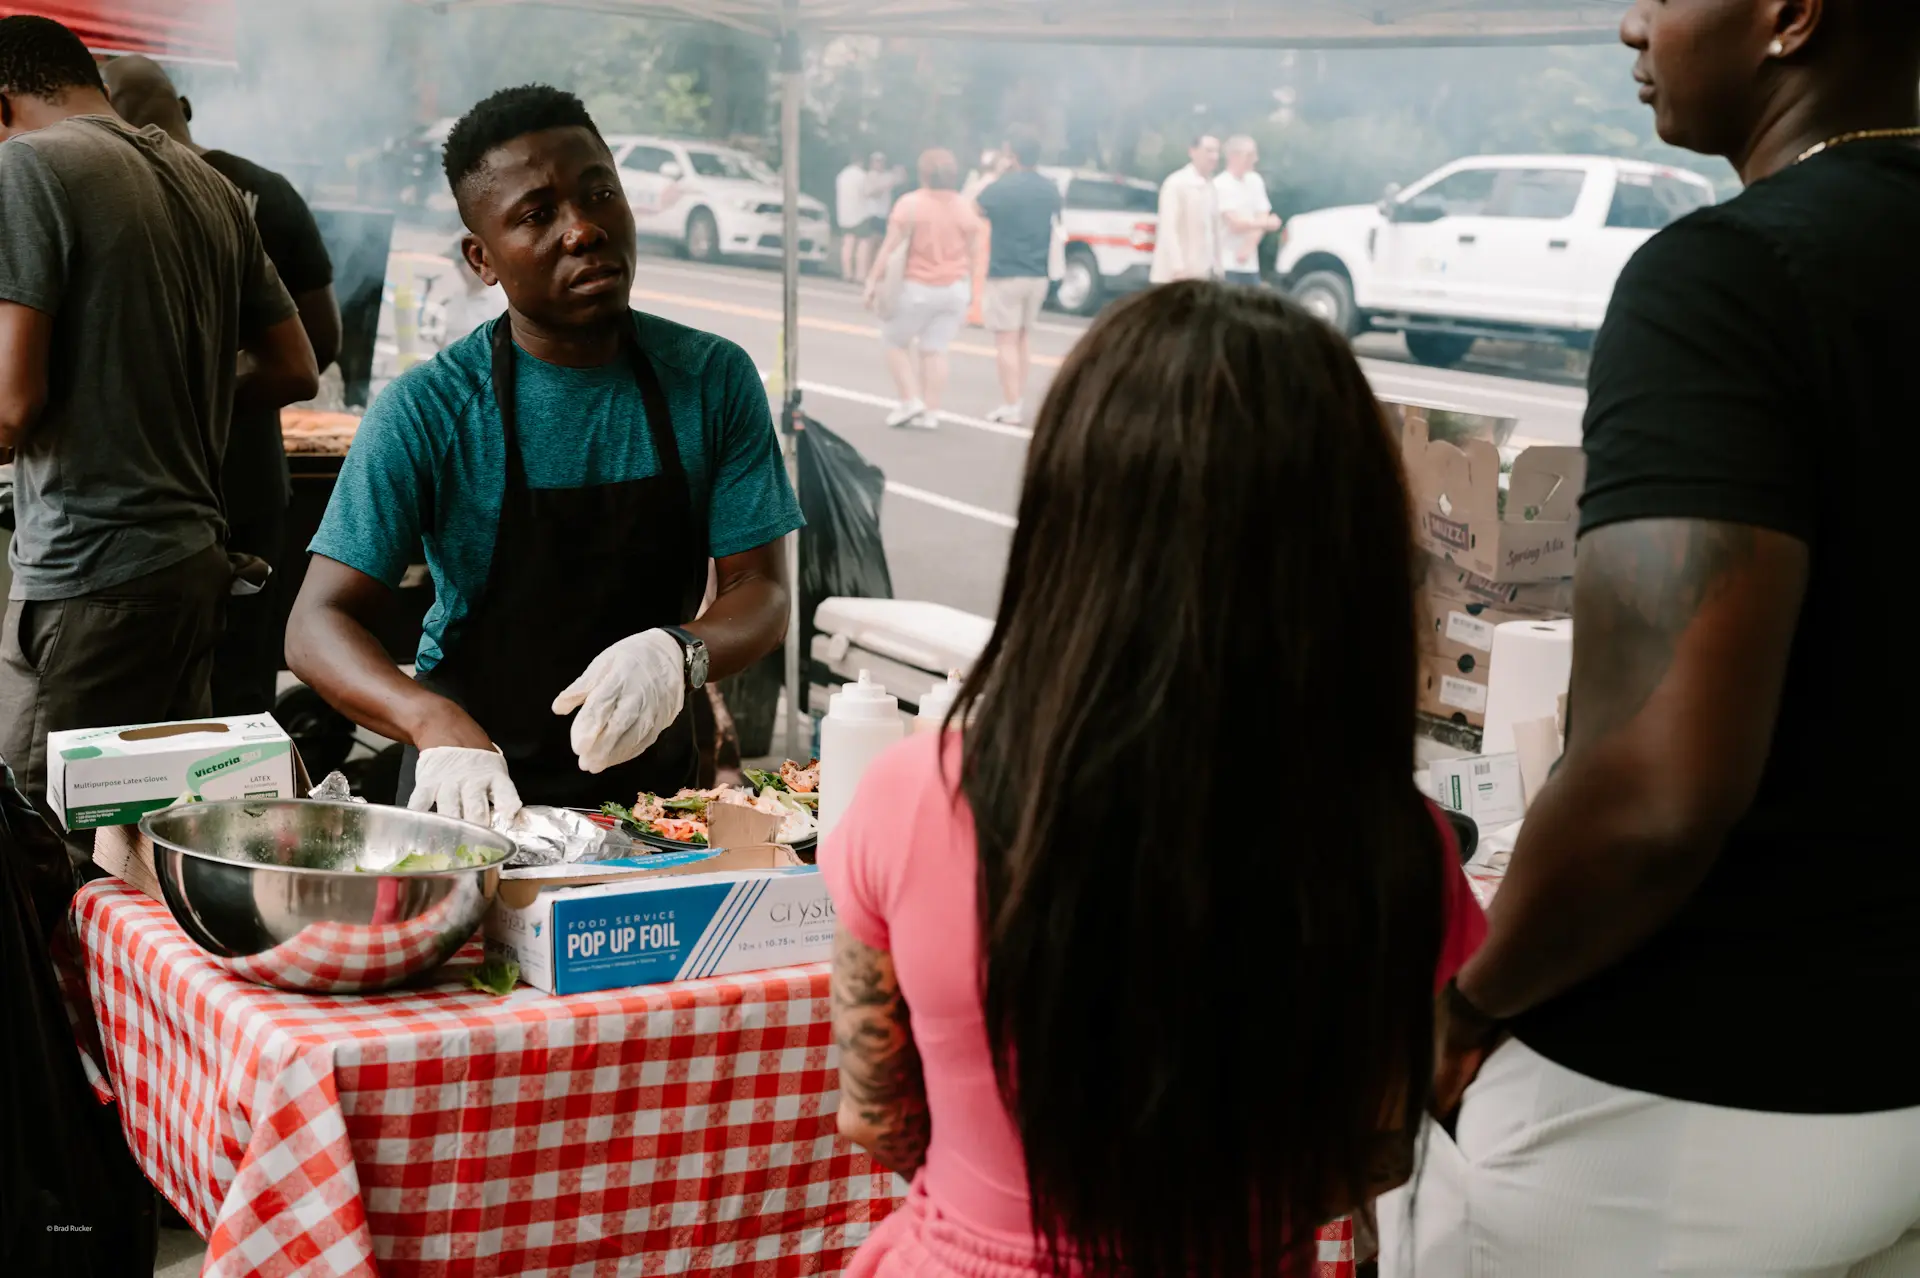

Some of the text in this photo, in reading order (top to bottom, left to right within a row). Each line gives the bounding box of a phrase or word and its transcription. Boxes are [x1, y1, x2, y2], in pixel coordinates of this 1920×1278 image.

[1506, 547, 1540, 571] Spring
[1542, 537, 1564, 555] Mix
[194, 756, 240, 778] Victoria
[73, 775, 168, 789] Multipurpose Latex Gloves
[250, 775, 271, 783] LATEX
[568, 910, 675, 930] FOOD SERVICE
[567, 930, 606, 959] POP
[610, 927, 636, 953] UP
[640, 922, 680, 950] FOIL
